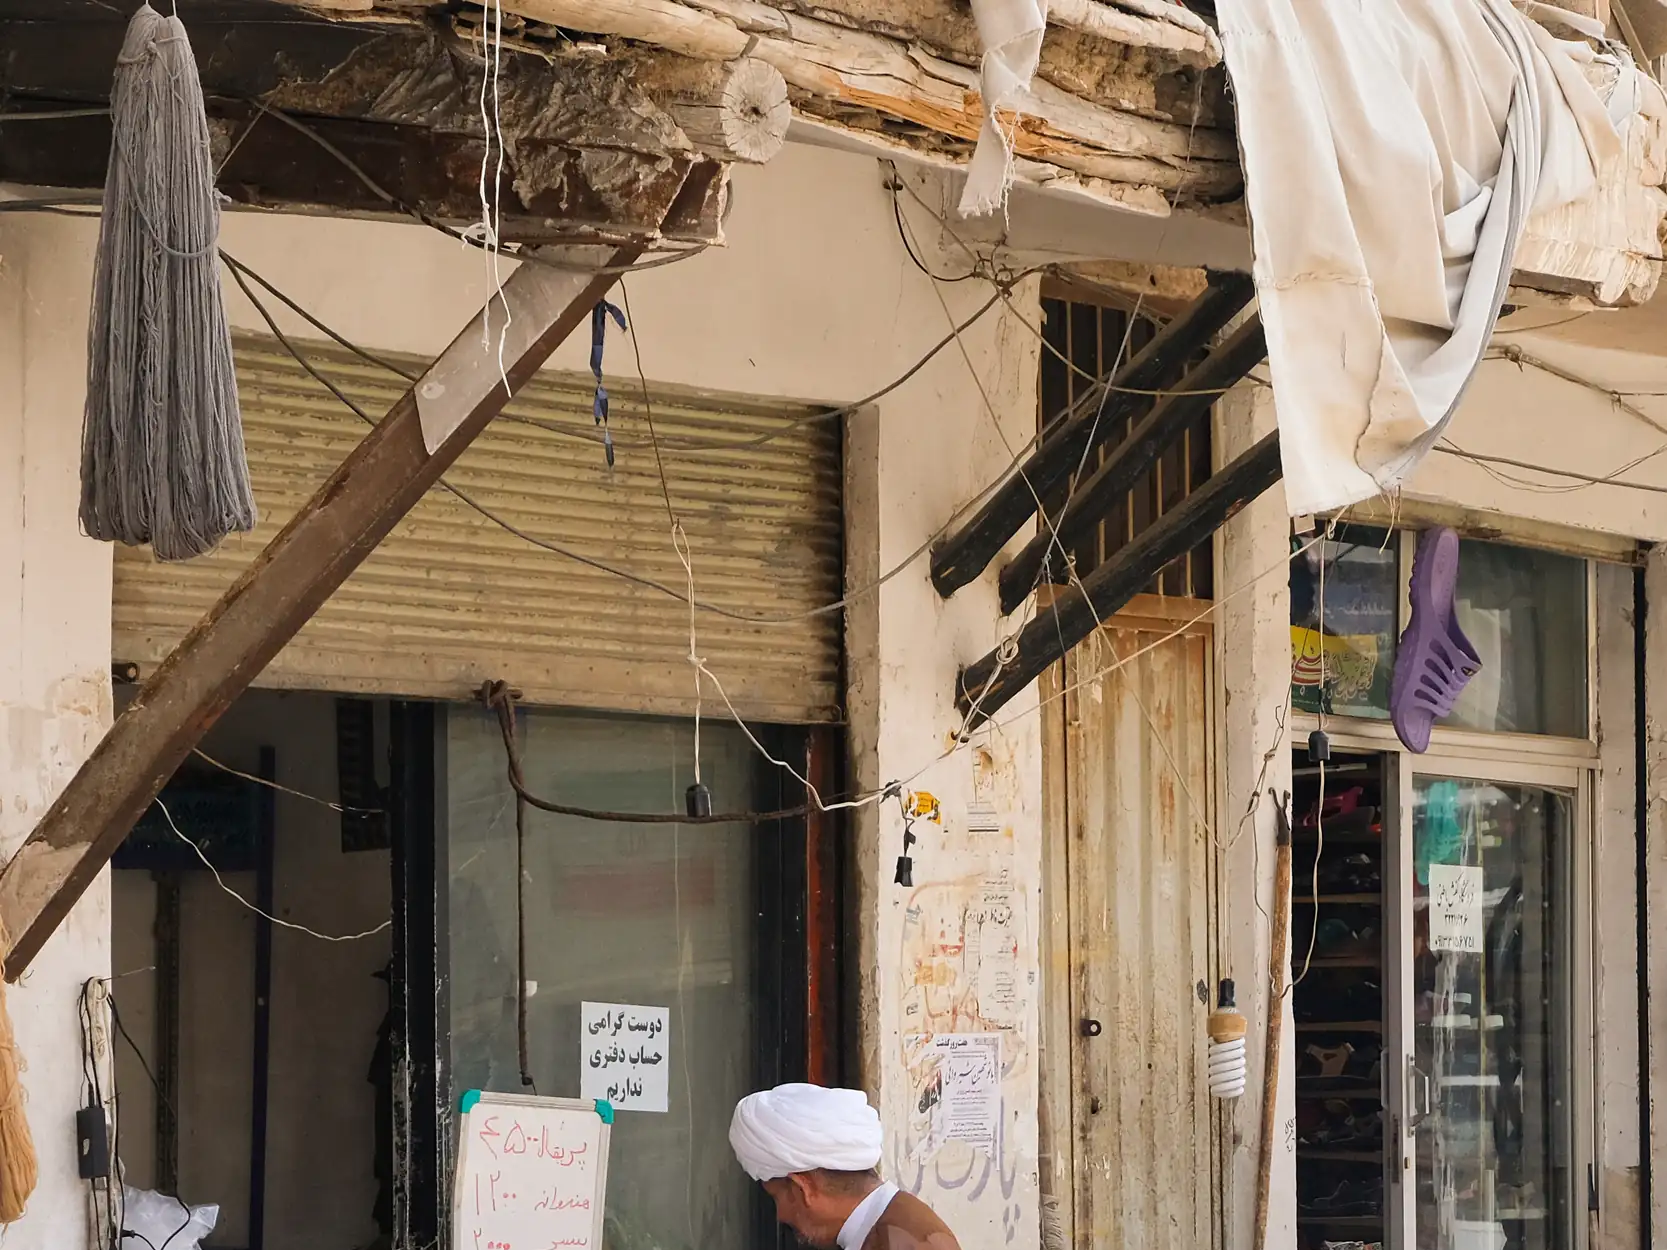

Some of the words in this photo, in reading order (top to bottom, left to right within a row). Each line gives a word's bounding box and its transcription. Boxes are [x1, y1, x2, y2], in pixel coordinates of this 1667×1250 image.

[588, 1009, 625, 1036] گرامی
[627, 1016, 663, 1039] دوست
[589, 1041, 626, 1069] دفتری
[629, 1045, 663, 1070] حساب
[607, 1077, 643, 1103] نداریم
[534, 1186, 590, 1212] هندوانه
